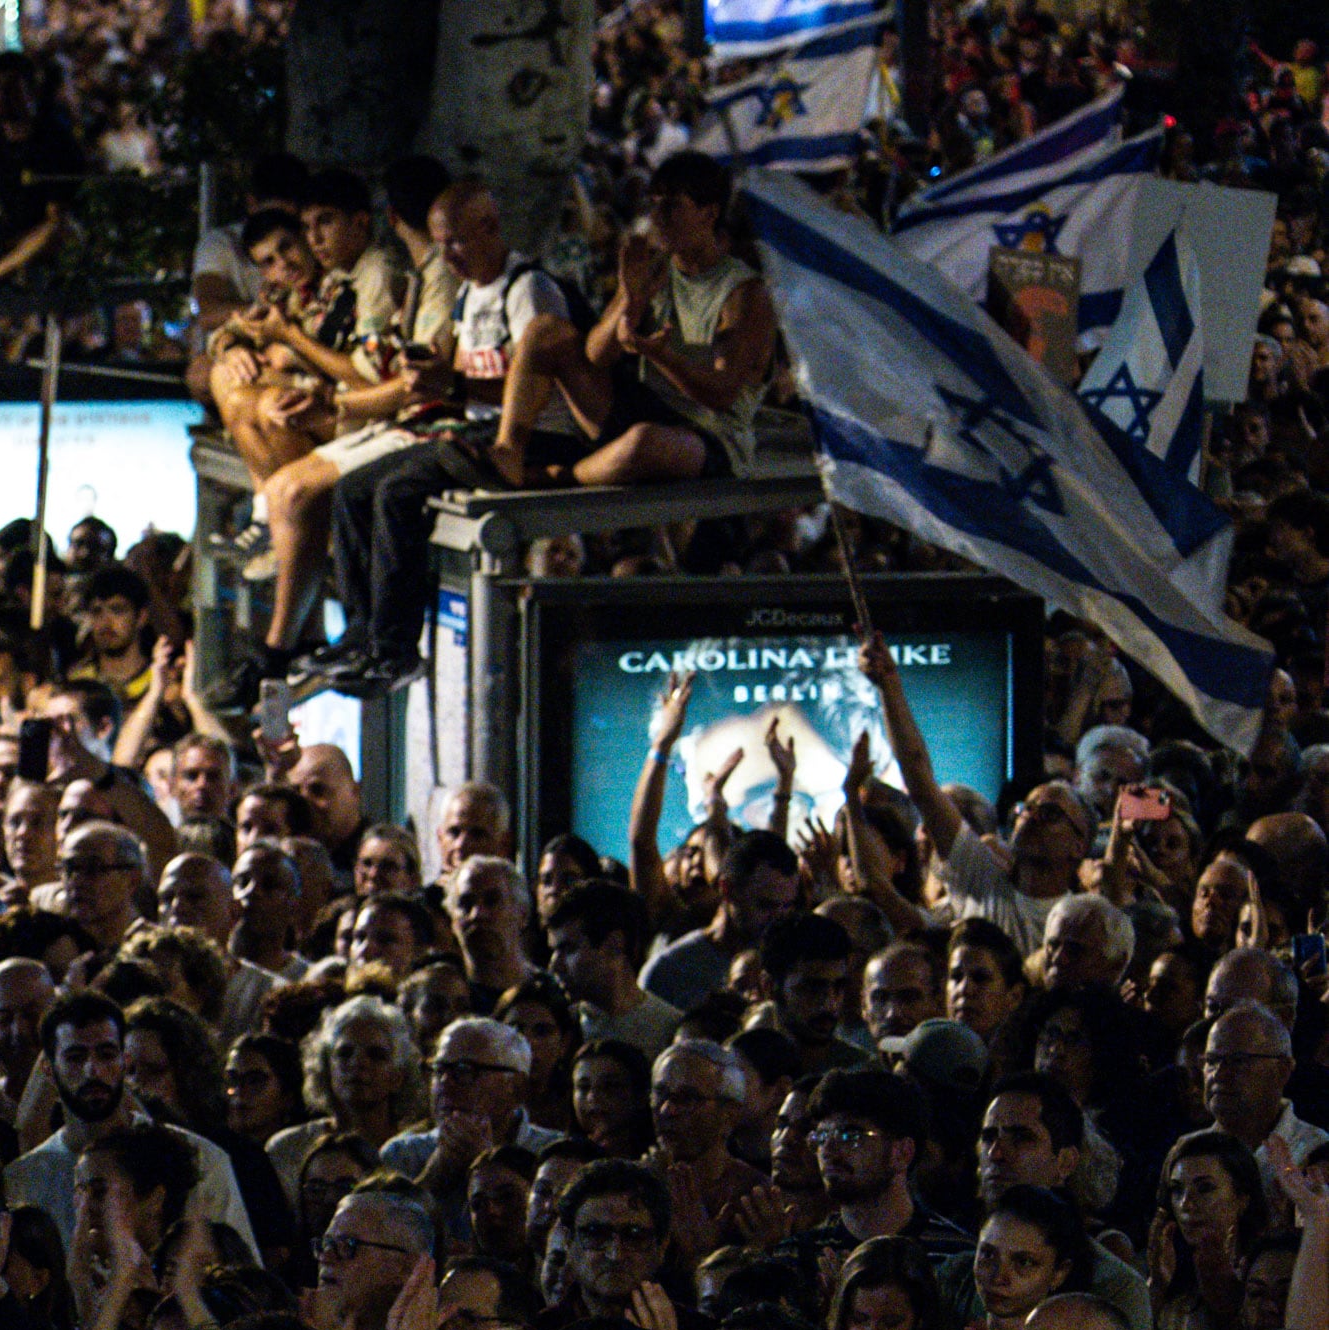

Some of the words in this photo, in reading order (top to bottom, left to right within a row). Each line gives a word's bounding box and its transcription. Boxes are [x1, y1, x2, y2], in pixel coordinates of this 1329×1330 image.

[618, 646, 816, 673] CAROLINA
[823, 643, 952, 670] LEKE
[733, 683, 843, 704] BERLIN
